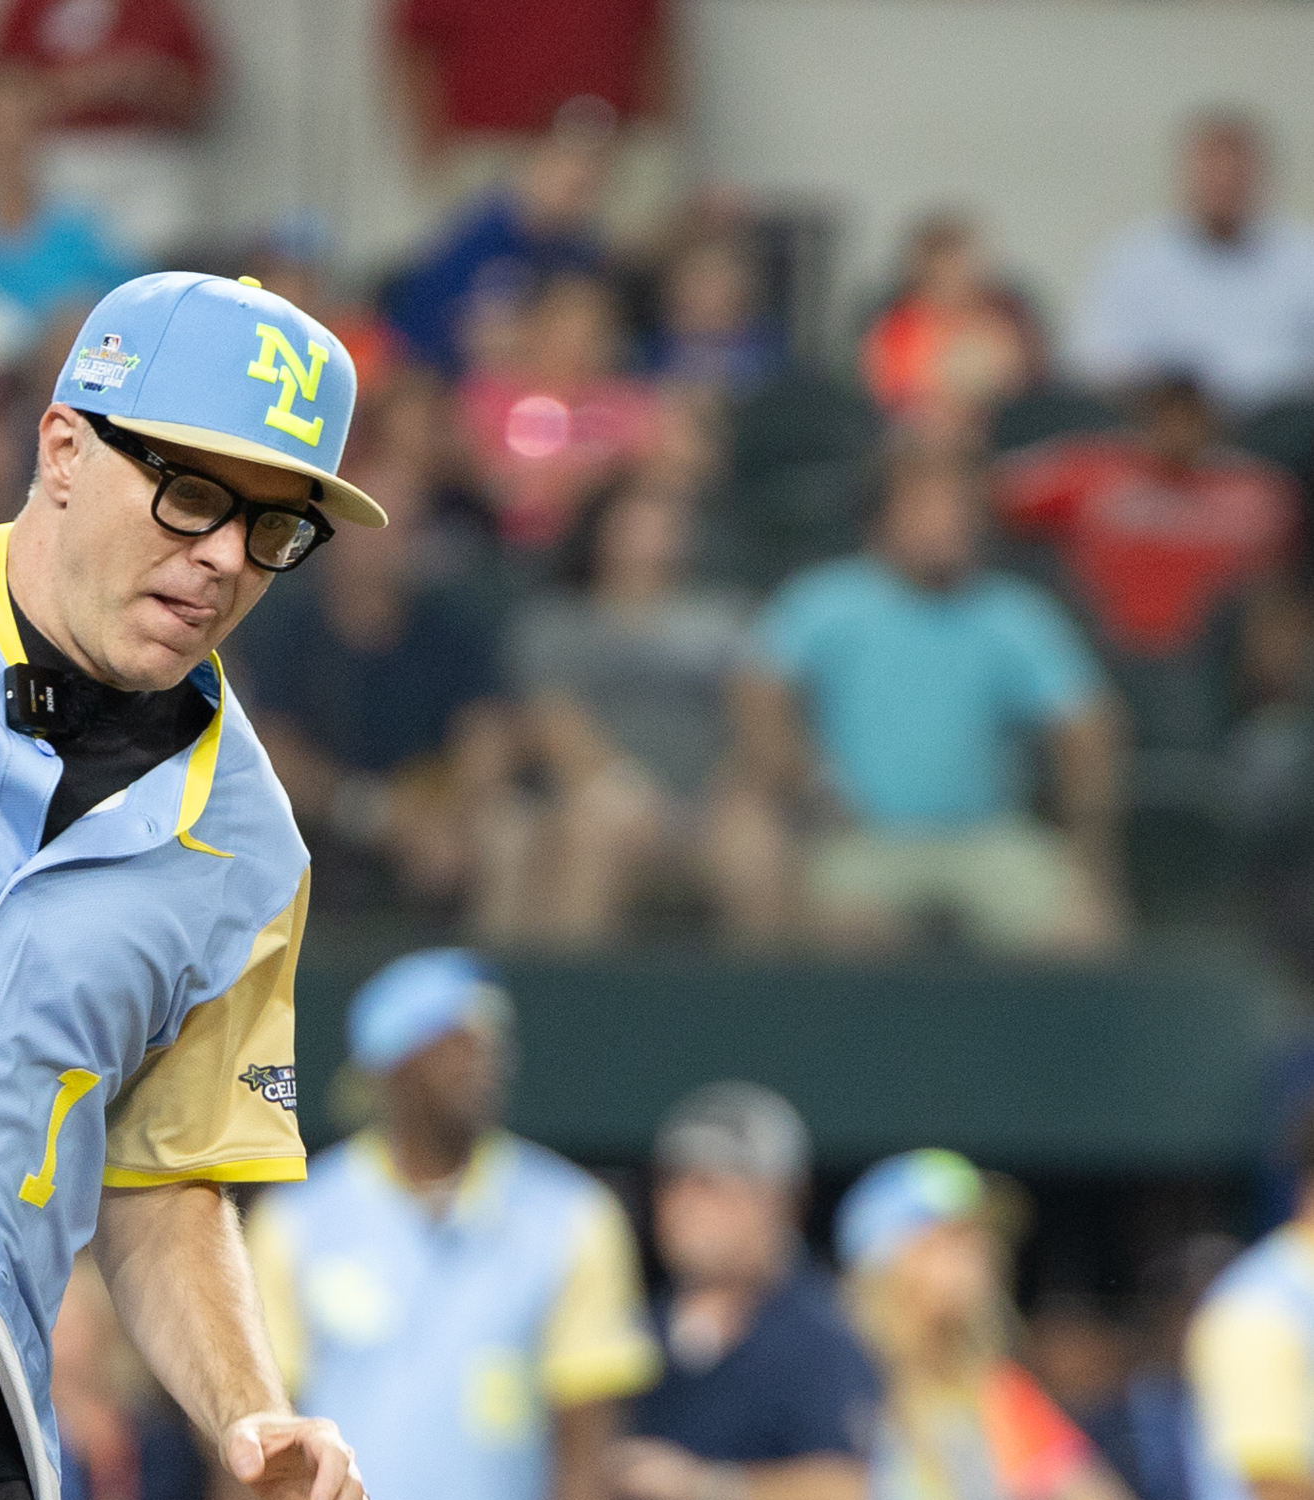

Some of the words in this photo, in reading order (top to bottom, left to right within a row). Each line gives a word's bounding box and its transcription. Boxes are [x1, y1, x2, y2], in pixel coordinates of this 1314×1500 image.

[76, 358, 131, 380] CELEBRITY
[248, 322, 329, 448] NL
[18, 1068, 102, 1209] 1
